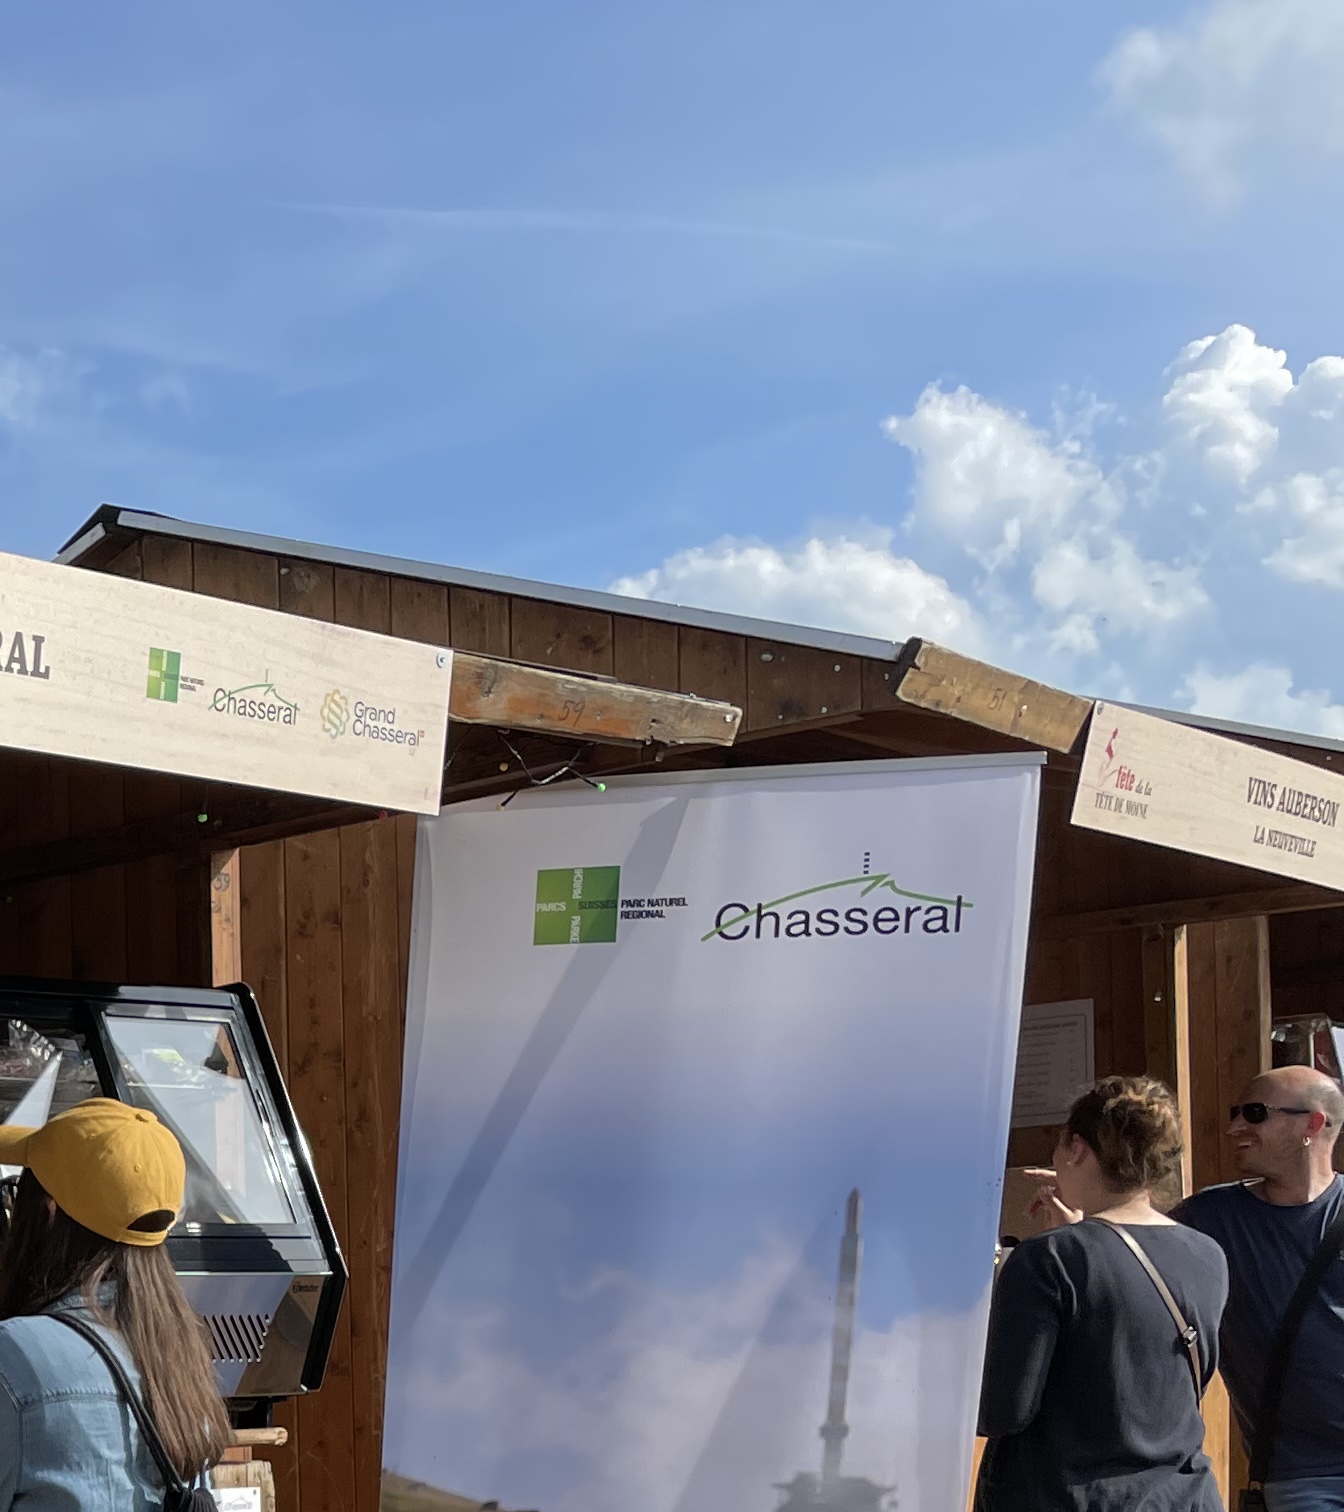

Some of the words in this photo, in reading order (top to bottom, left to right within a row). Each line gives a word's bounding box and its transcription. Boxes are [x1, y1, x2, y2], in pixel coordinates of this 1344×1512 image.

[213, 687, 298, 726] Chasseral
[354, 701, 396, 725] Grand
[352, 719, 420, 748] Chasseral
[1115, 764, 1136, 792] fête
[1114, 796, 1125, 812] DE
[1125, 798, 1149, 820] MOINE
[1247, 776, 1277, 810] VINS
[1277, 786, 1340, 828] AUBERSON
[1253, 825, 1265, 844] LA
[1266, 829, 1317, 858] NEUVEVILLE
[536, 901, 567, 913] PARCS
[620, 909, 666, 920] REGIONAL
[621, 899, 646, 909] PARC
[647, 897, 688, 908] NATUREL
[714, 895, 963, 941] Chasseral
